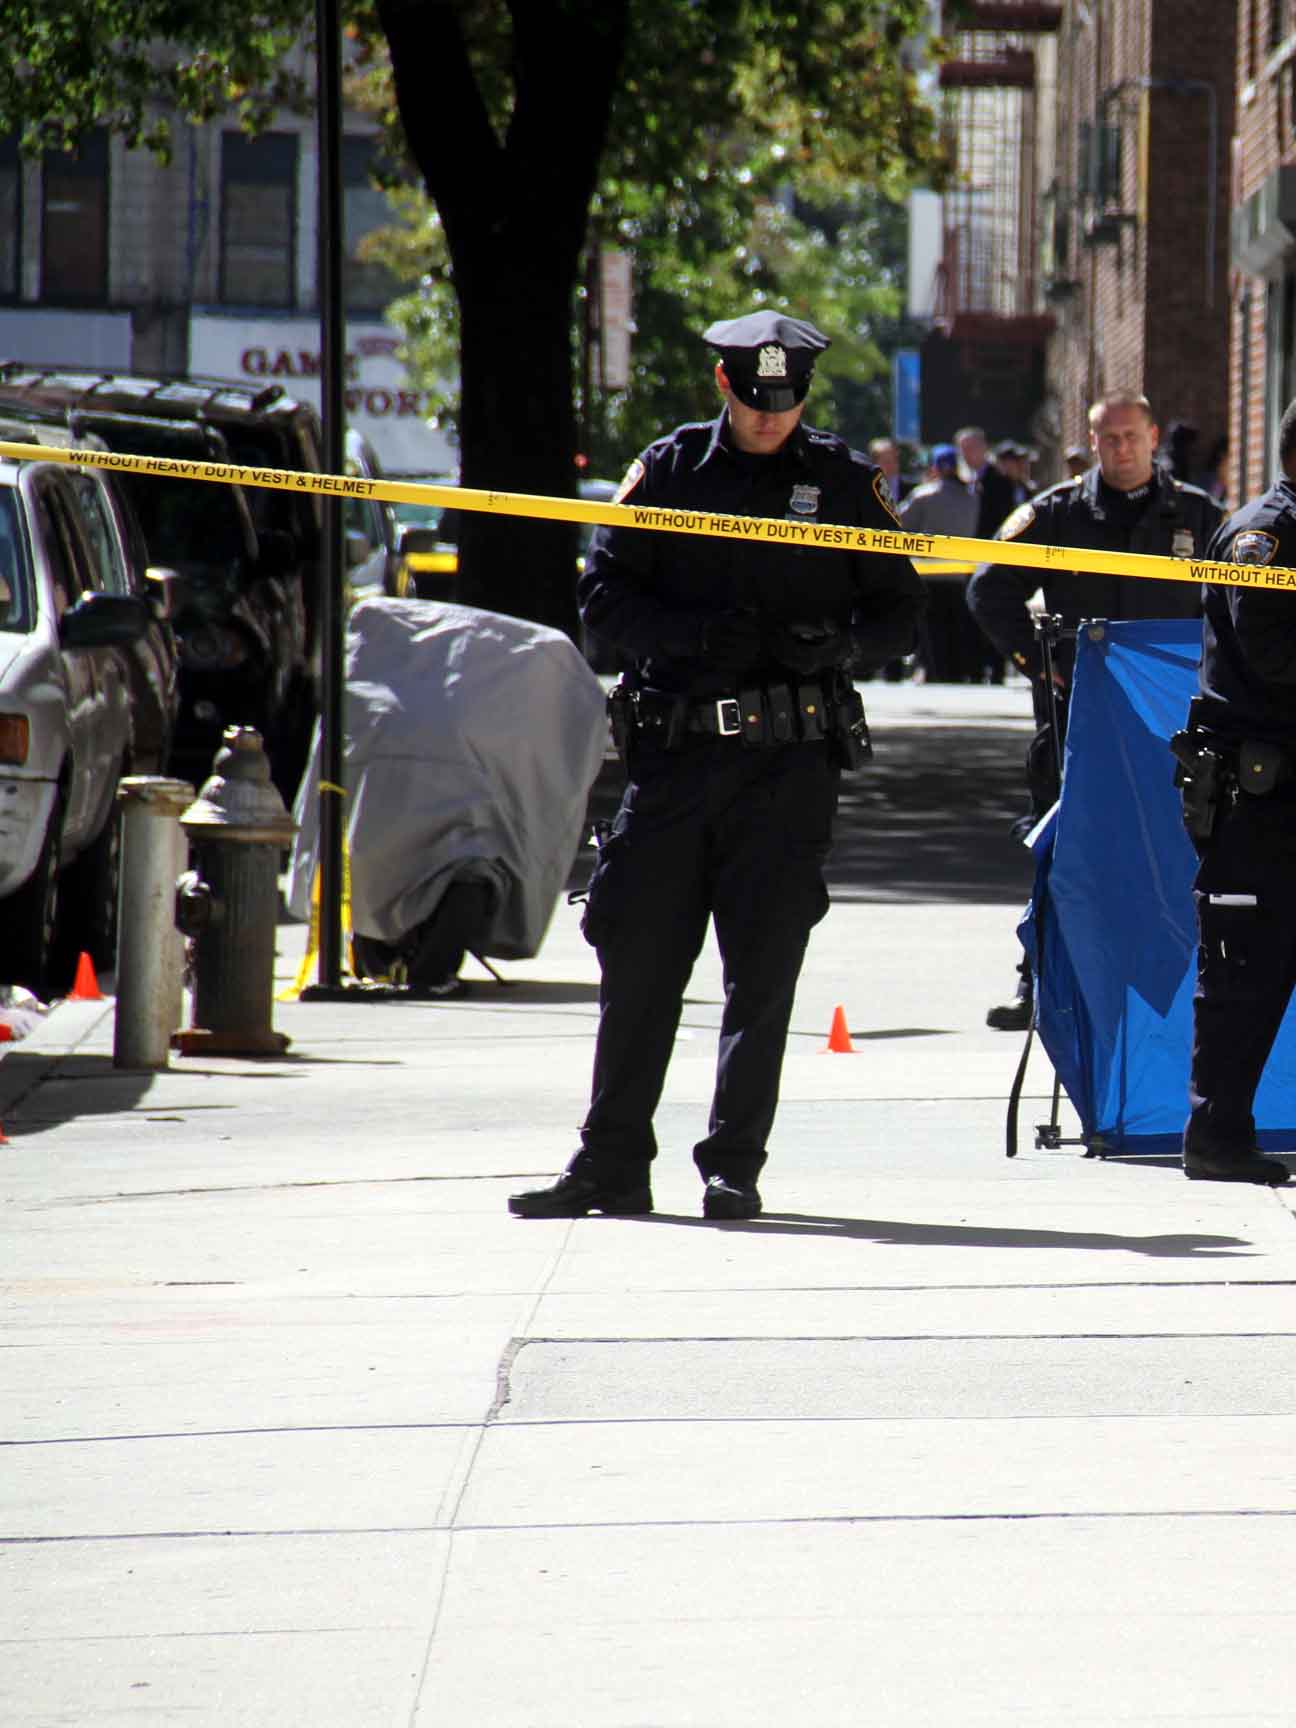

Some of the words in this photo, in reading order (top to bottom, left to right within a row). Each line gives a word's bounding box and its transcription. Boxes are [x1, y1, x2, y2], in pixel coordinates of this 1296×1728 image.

[69, 452, 140, 469] WITHOUT
[145, 459, 201, 475] HEAVY
[204, 465, 249, 480] DUTY
[252, 471, 290, 485] VEST
[296, 475, 306, 487] &
[311, 477, 376, 495] HELMET
[633, 511, 706, 529] WITHOUT
[709, 518, 762, 535] HEAVY
[767, 524, 809, 539] DUTY
[813, 529, 853, 544] VEST
[857, 533, 867, 546] &
[872, 534, 935, 553] HELMET
[1189, 566, 1261, 583] WITHOUT
